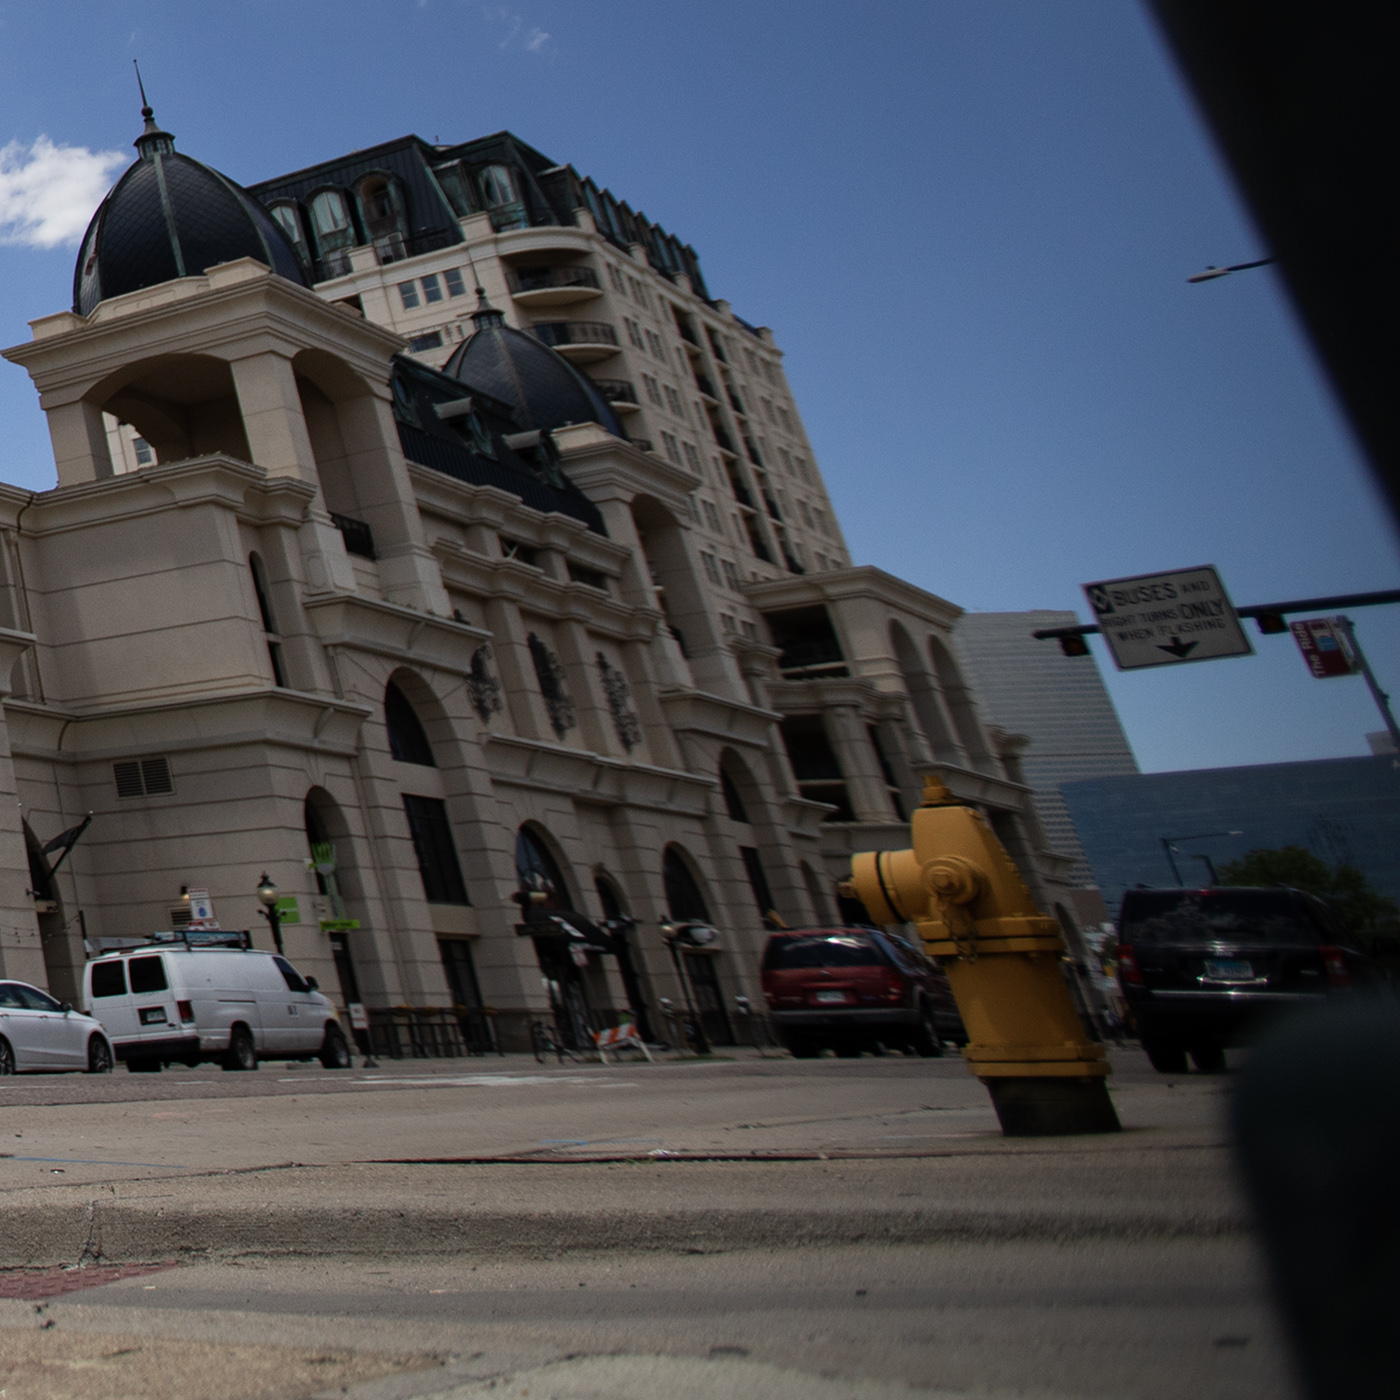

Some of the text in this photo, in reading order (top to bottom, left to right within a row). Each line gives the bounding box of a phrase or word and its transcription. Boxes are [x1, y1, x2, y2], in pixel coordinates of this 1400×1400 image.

[1111, 580, 1210, 607] BUSES AND
[1101, 598, 1226, 628] RIGHT TURNS ONLY
[1117, 618, 1226, 642] WHEN FLASHING
[1295, 622, 1314, 650] Ride
[1309, 654, 1326, 677] The
